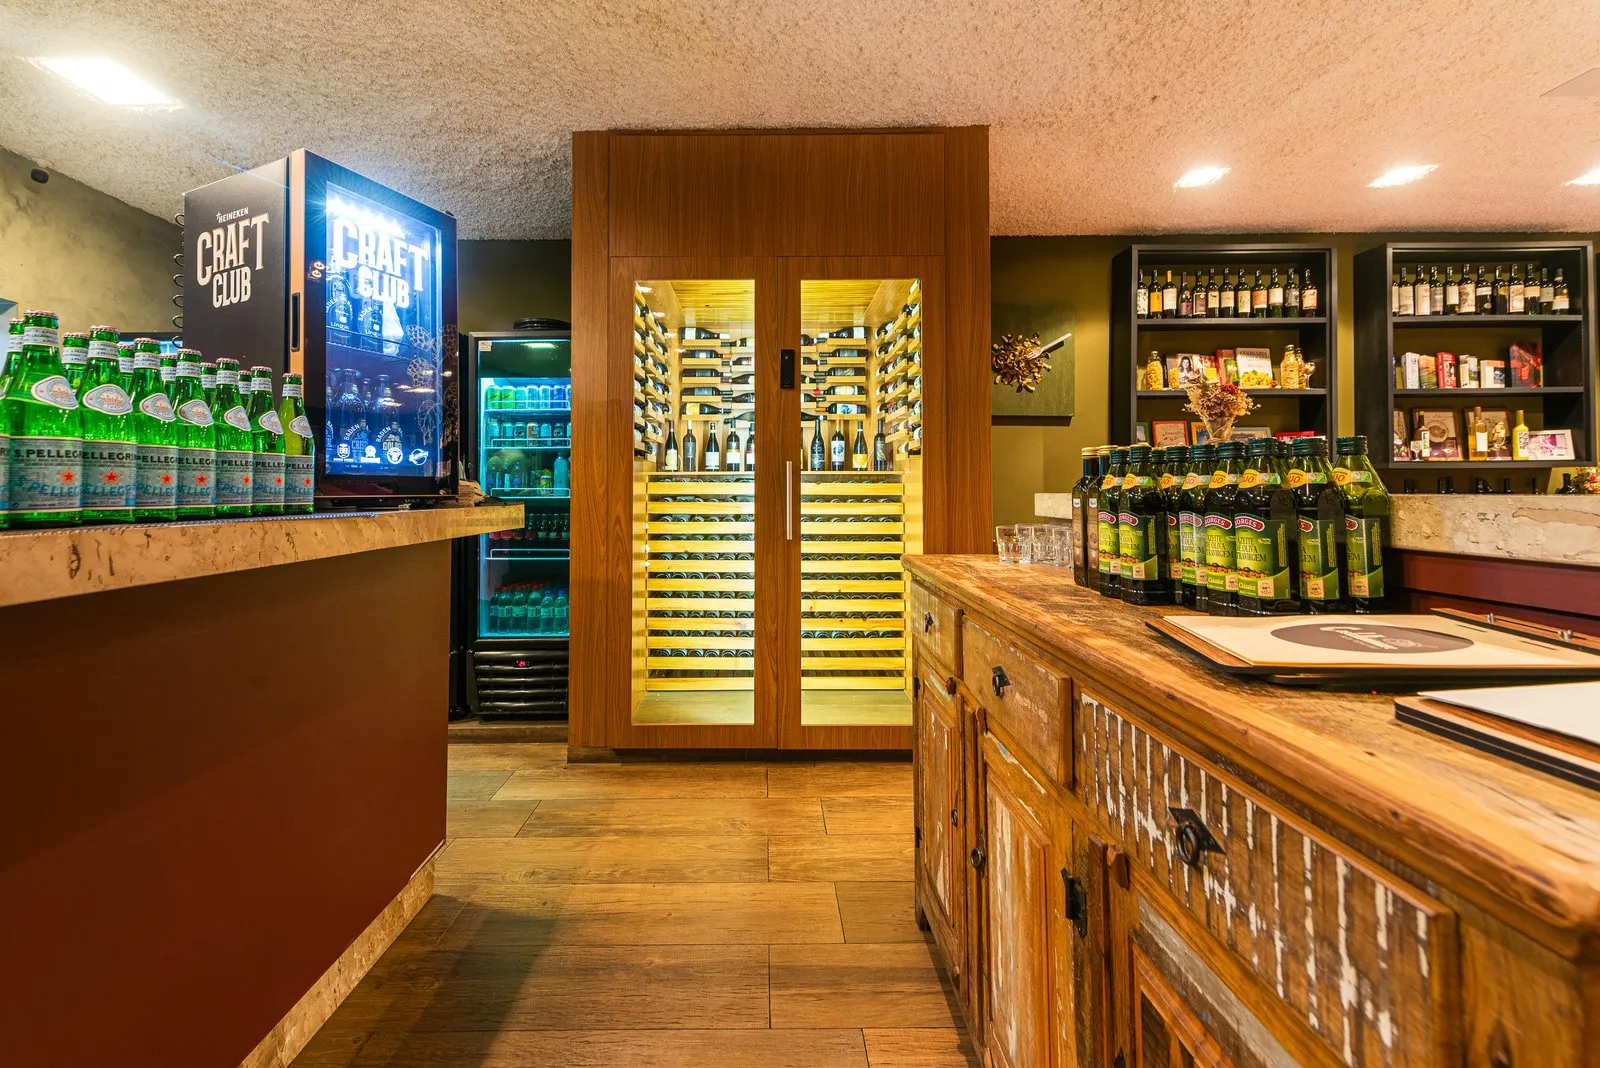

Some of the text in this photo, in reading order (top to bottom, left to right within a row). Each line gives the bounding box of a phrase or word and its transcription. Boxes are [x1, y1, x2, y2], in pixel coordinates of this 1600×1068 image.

[218, 207, 249, 223] HEINEKEN
[197, 212, 269, 286] CRAFT
[333, 219, 430, 292] CRAFT
[213, 266, 251, 308] CLUB
[358, 265, 410, 309] CLUB
